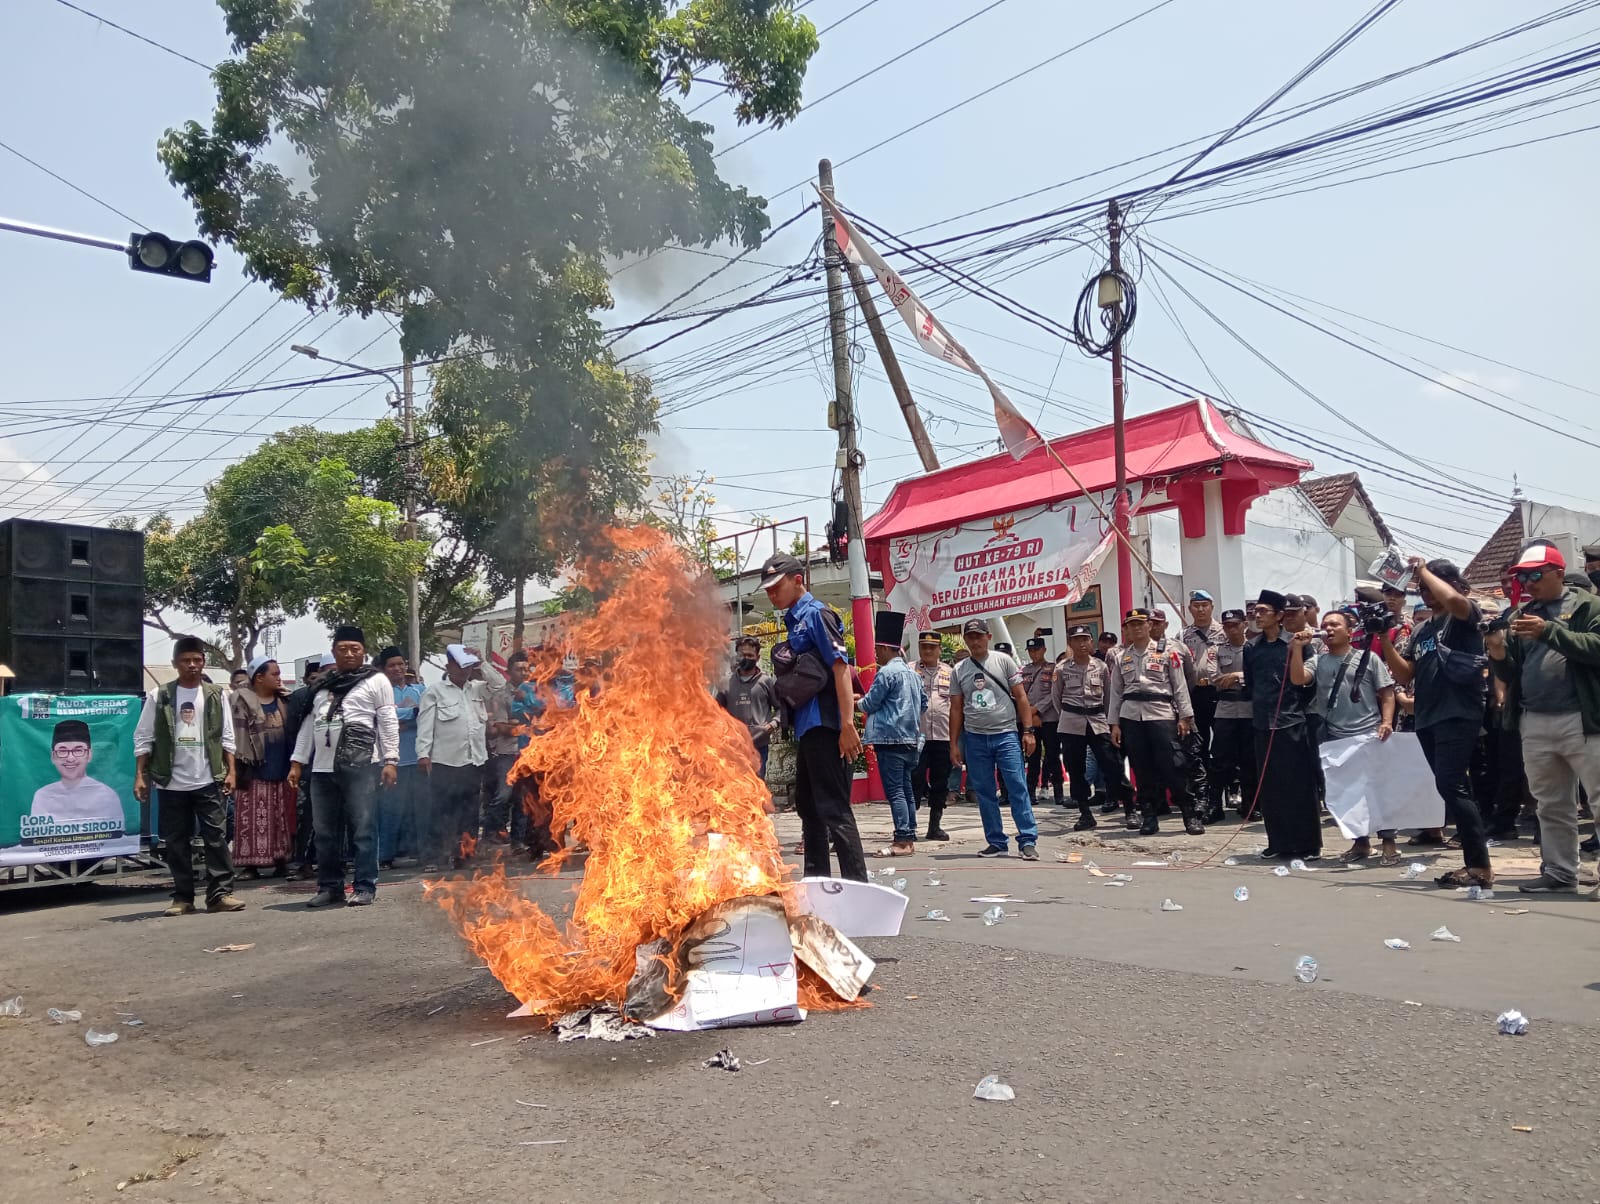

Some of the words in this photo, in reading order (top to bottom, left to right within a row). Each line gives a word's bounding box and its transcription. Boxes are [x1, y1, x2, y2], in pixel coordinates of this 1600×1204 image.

[956, 554, 980, 570] HUT
[984, 546, 1021, 564] KE-79
[1026, 541, 1040, 555] RI
[958, 561, 1036, 587] DIRGAHAYU
[932, 582, 990, 605] REPUBLIK
[994, 567, 1071, 593] INDONESIA
[940, 609, 952, 618] RW
[952, 607, 960, 616] 01
[960, 599, 1005, 614] KELURAHAN
[1006, 588, 1056, 606] KEPUHARJO
[56, 707, 128, 716] BERINTEGRITAS
[91, 699, 128, 708] CERDAS
[22, 815, 54, 826] LORA
[22, 824, 80, 837] GHUFRON
[82, 820, 122, 833] SIRODJ
